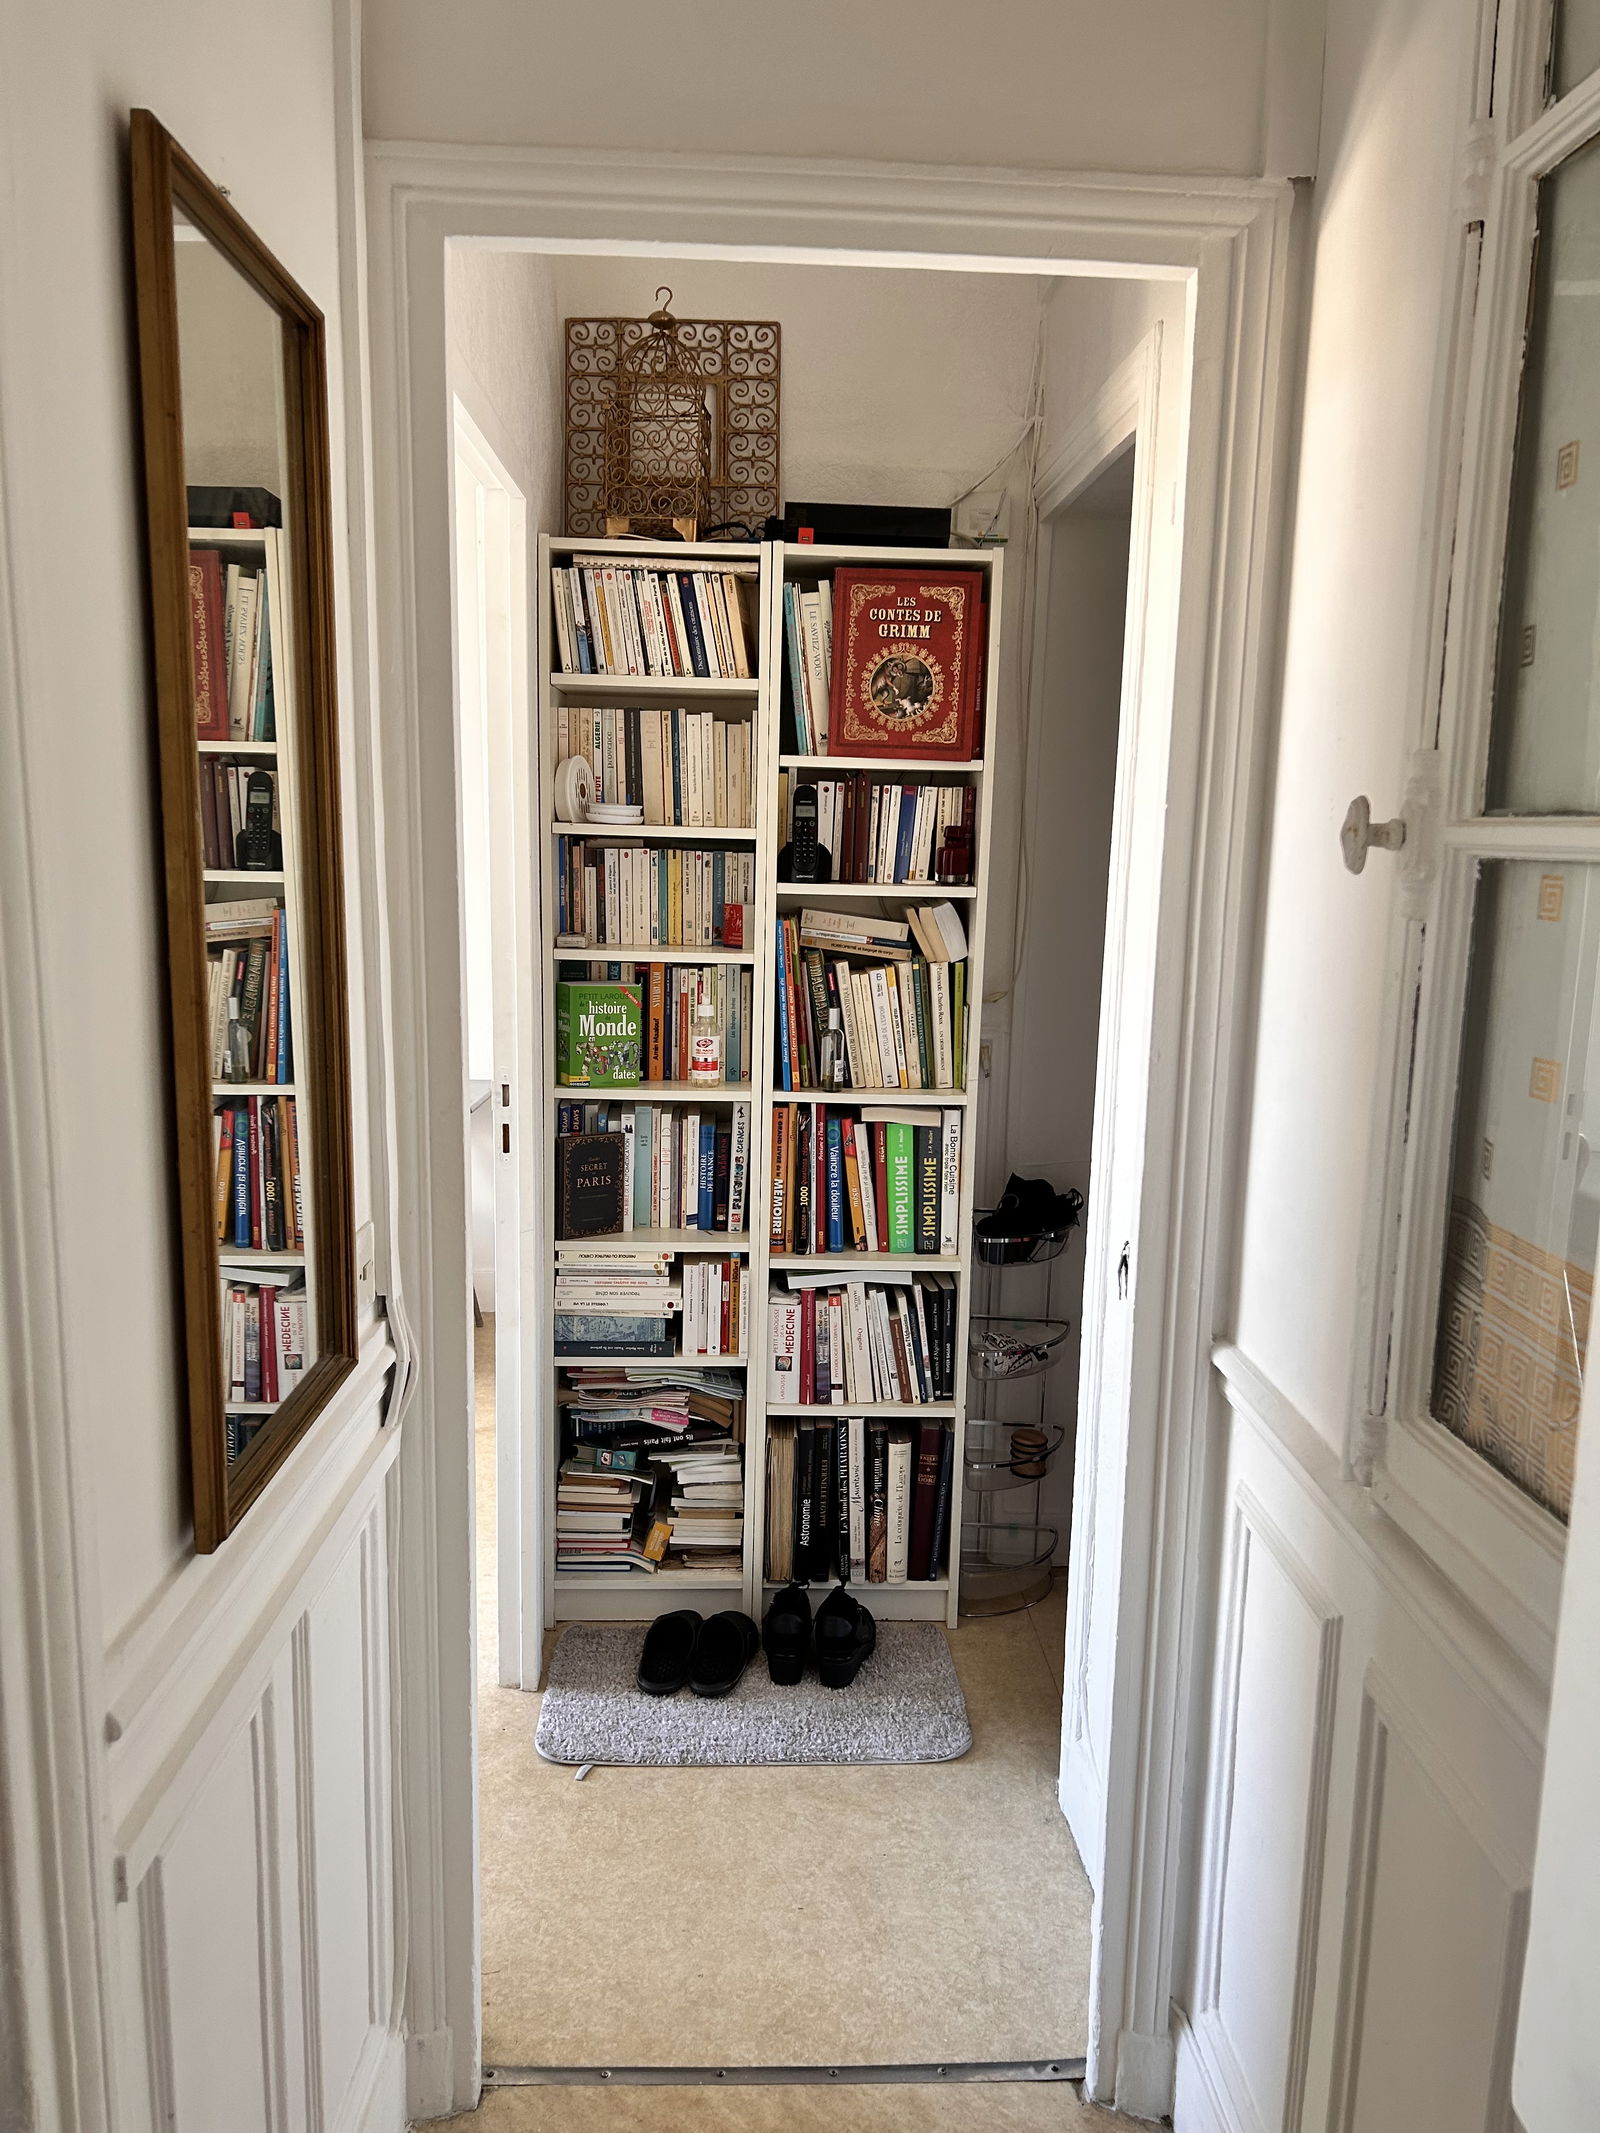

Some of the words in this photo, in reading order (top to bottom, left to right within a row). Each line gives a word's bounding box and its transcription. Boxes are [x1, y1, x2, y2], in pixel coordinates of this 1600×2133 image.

[688, 601, 696, 624] citations
[897, 597, 916, 606] LES
[810, 611, 817, 621] LE
[869, 609, 921, 621] CONTES
[925, 611, 942, 622] DE
[878, 625, 930, 638] GRIMM
[695, 636, 704, 670] Dictionnaire
[607, 731, 615, 769] provence
[579, 1014, 636, 1036] Monde
[613, 1067, 636, 1079] dates
[736, 1122, 744, 1153] SCIENCES
[950, 1124, 958, 1134] La
[949, 1136, 958, 1163] Bonne
[580, 1162, 608, 1172] SECRET
[830, 1146, 839, 1178] Vaincre
[576, 1175, 612, 1188] PARIS
[708, 1182, 714, 1192] DE
[831, 1180, 840, 1188] la
[948, 1165, 957, 1195] Cuisine
[772, 1178, 785, 1234] MÉMOIRE
[800, 1186, 809, 1206] 1000
[831, 1190, 840, 1222] douleur
[895, 1156, 909, 1235] SIMPLISSIME
[923, 1157, 937, 1237] SIMPLISSIME
[782, 1309, 795, 1354] MÉDECINE
[643, 1437, 659, 1445] Paris
[840, 1426, 848, 1478] PHARAONS
[840, 1480, 848, 1493] des
[850, 1464, 864, 1512] Mauritanie
[840, 1495, 848, 1521] Monde
[895, 1494, 903, 1503] de
[799, 1499, 811, 1546] Astronomie
[873, 1499, 883, 1526] Chine
[840, 1522, 849, 1533] Le
[895, 1534, 902, 1544] La
